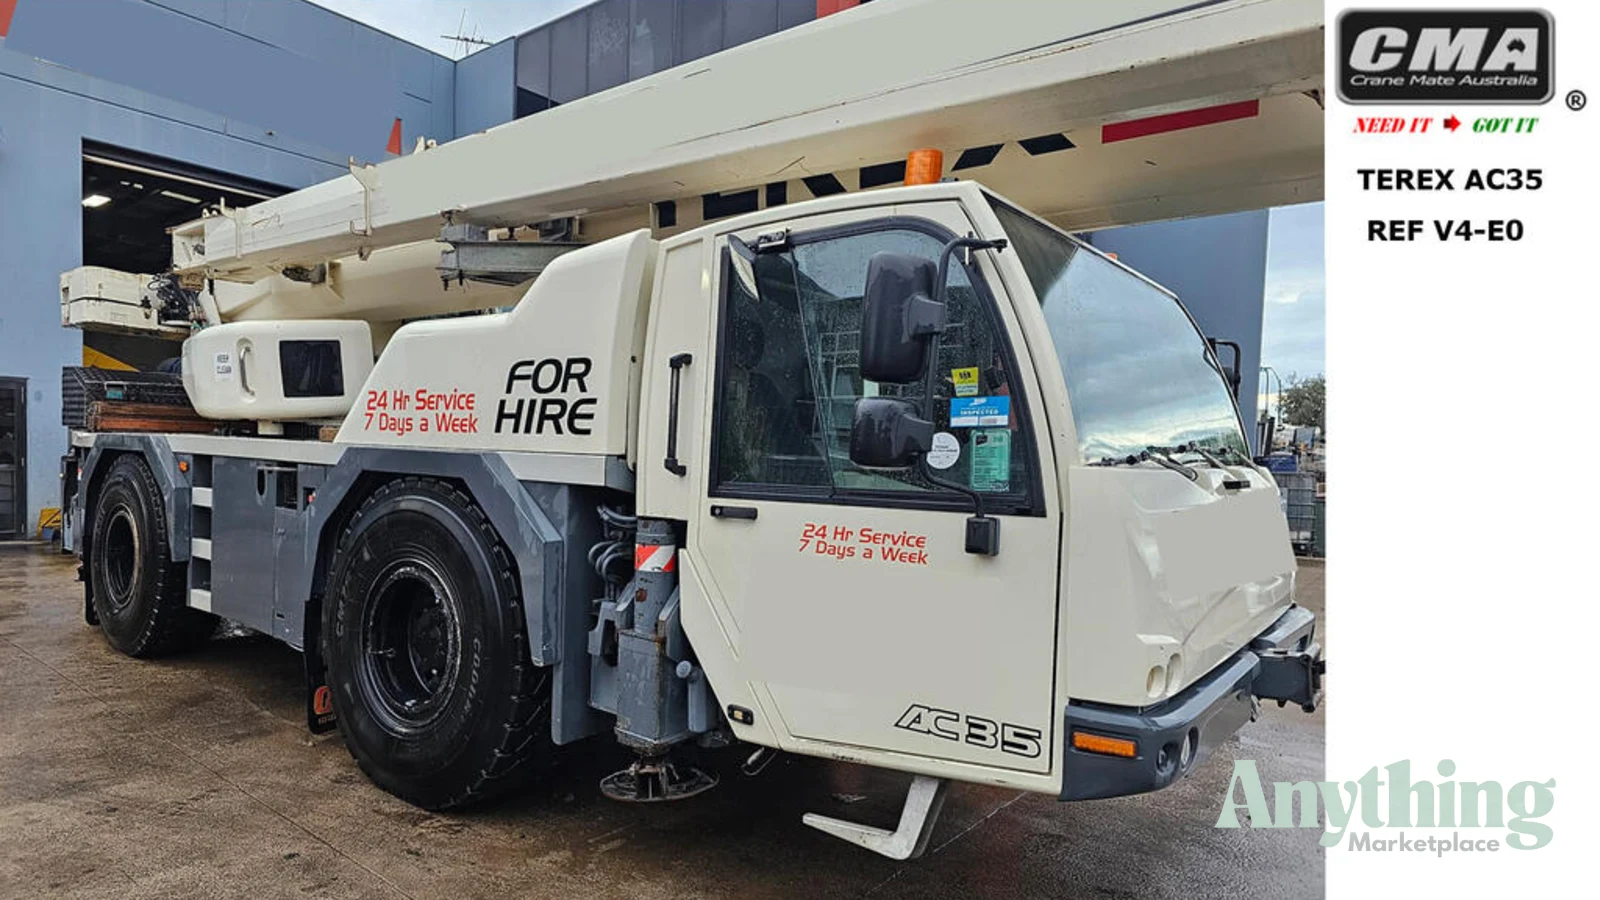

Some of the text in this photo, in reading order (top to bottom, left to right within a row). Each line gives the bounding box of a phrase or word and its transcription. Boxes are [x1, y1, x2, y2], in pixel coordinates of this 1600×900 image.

[505, 357, 592, 394] FOR
[367, 388, 475, 410] 24 Hr Service
[364, 412, 478, 436] 7 Days a Week
[494, 398, 597, 435] HIRE
[803, 523, 927, 548] 24 Hr Service
[799, 539, 929, 565] 7 Days a Week
[894, 704, 1042, 758] AC35
